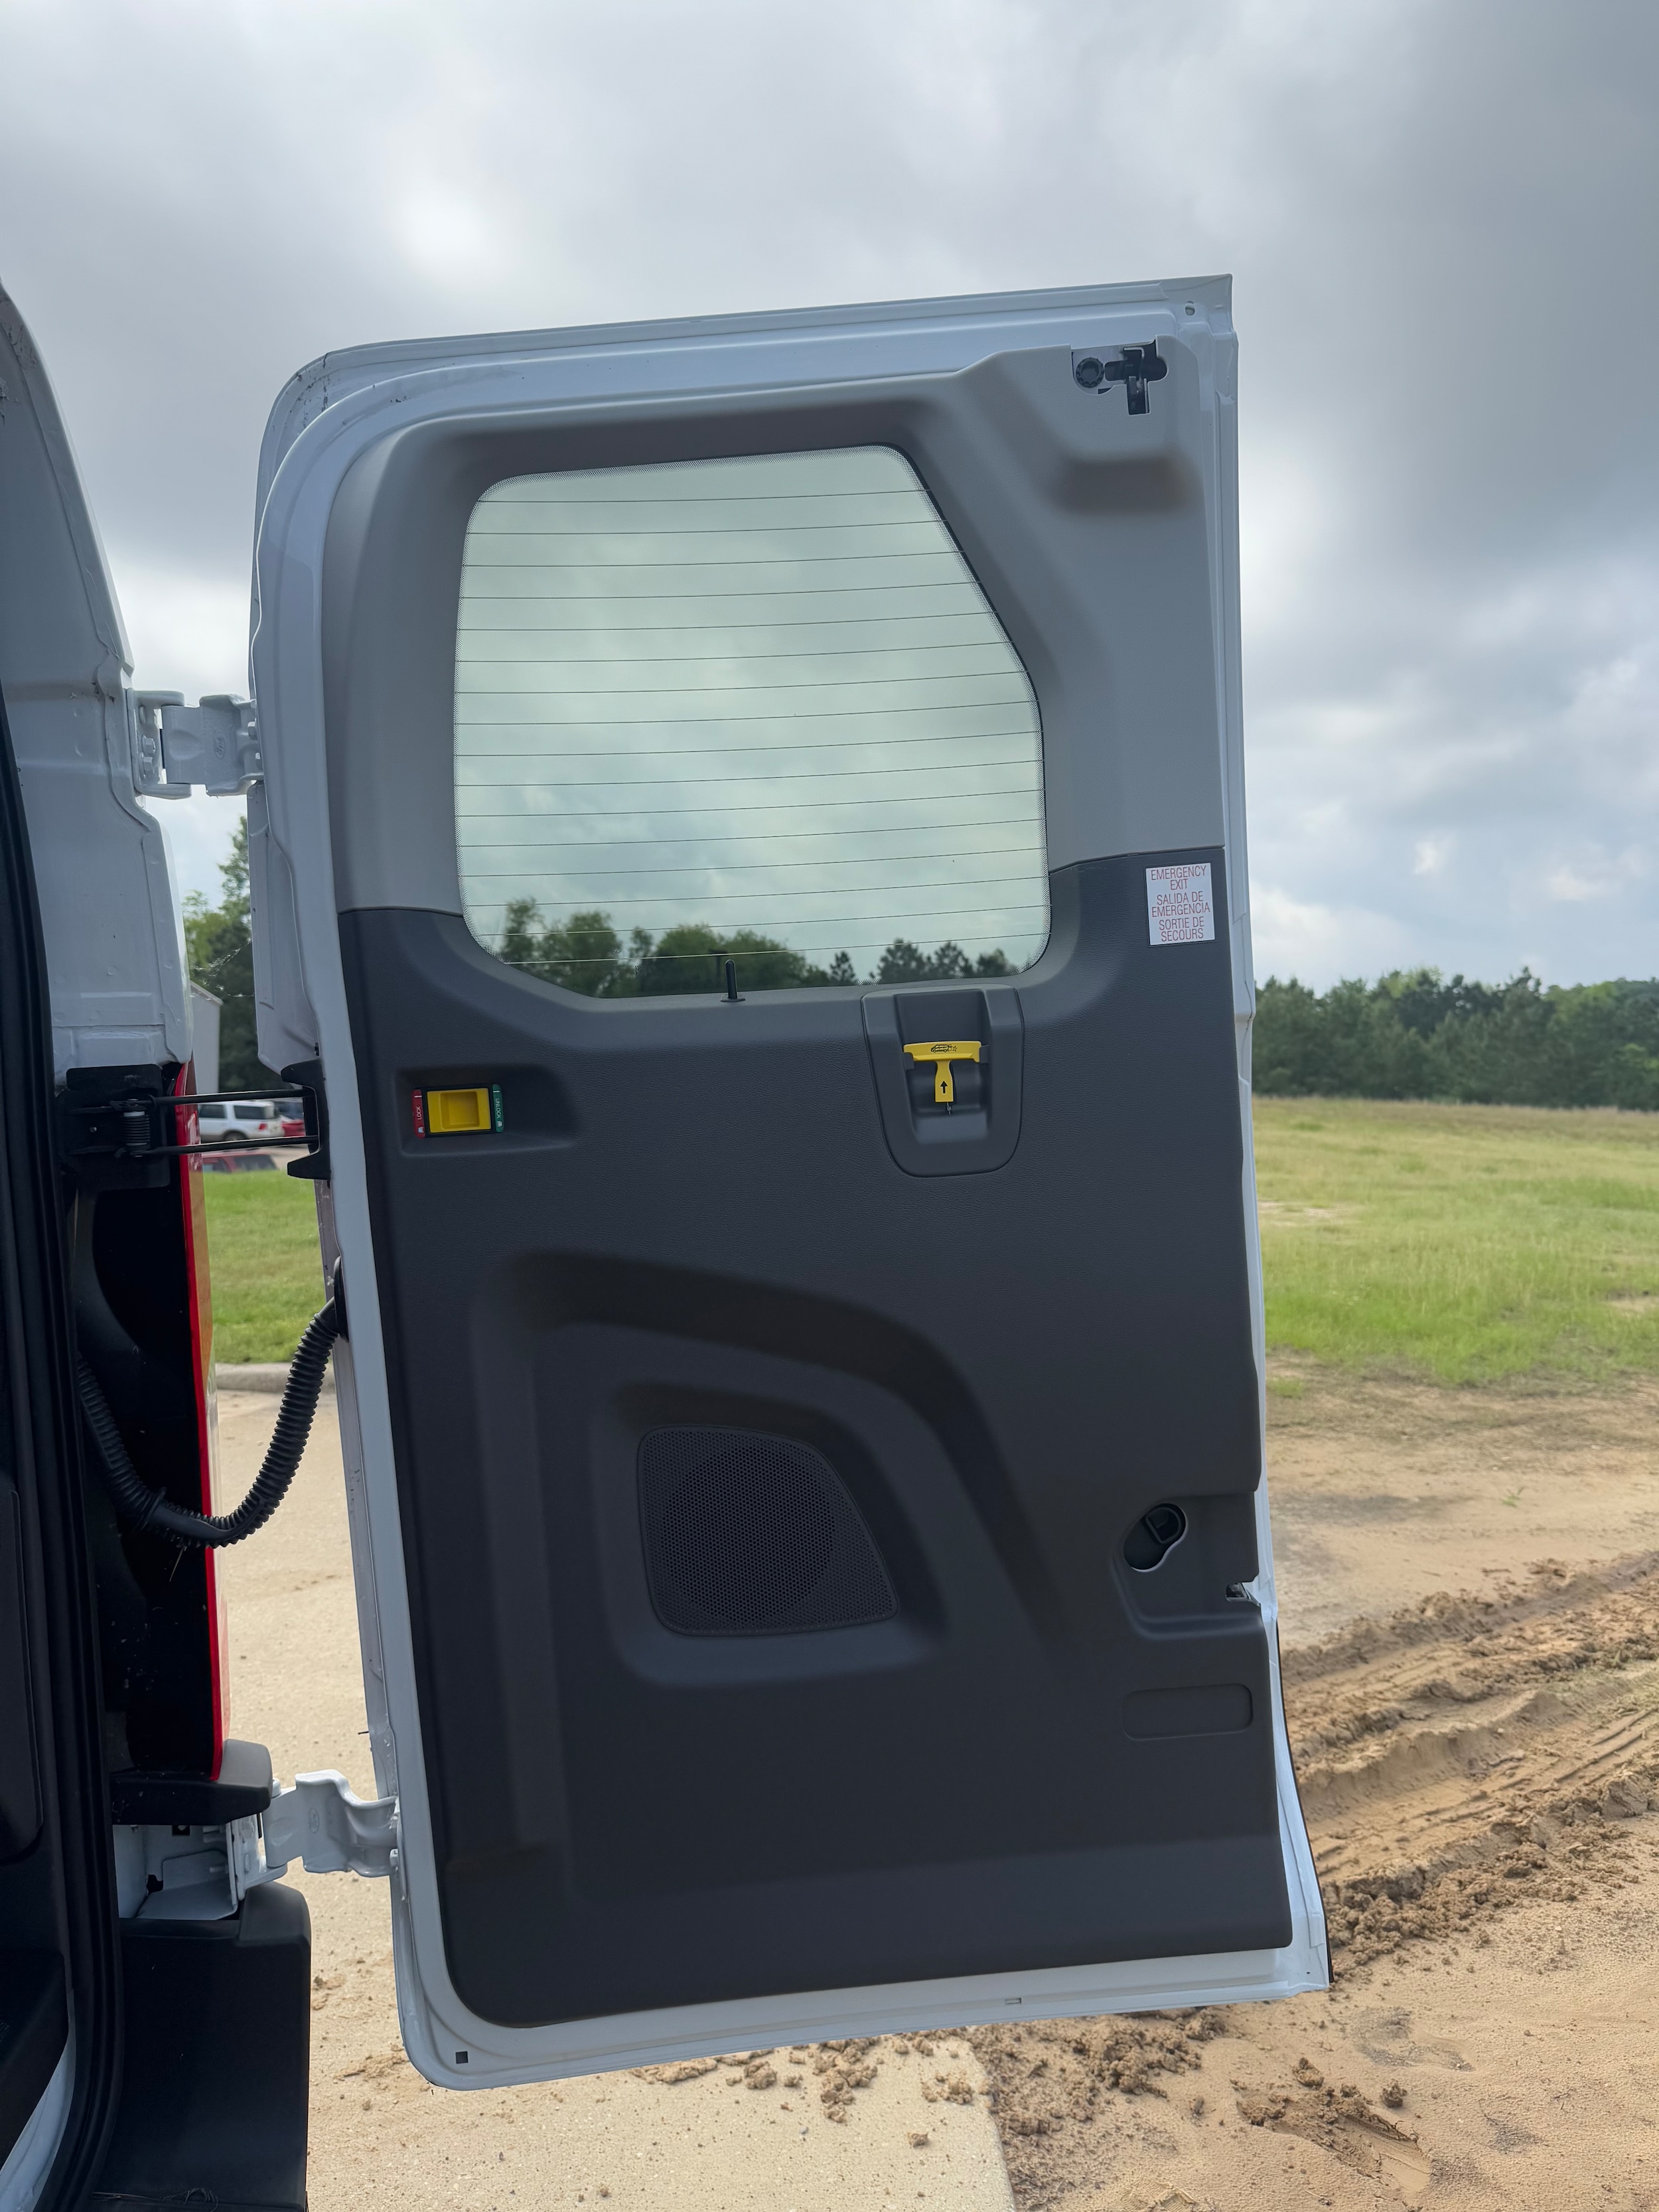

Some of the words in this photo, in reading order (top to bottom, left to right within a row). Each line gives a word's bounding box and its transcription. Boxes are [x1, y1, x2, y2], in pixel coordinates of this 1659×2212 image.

[1151, 865, 1206, 881] EMERGENCY
[1170, 878, 1189, 891] EXIT
[1157, 893, 1189, 905] SALIDA
[1192, 891, 1204, 903] DE
[1151, 903, 1210, 917] EMERGENCIA
[1159, 917, 1190, 930] SORTIE
[1192, 916, 1204, 928] DE
[1161, 928, 1204, 942] SECOURS
